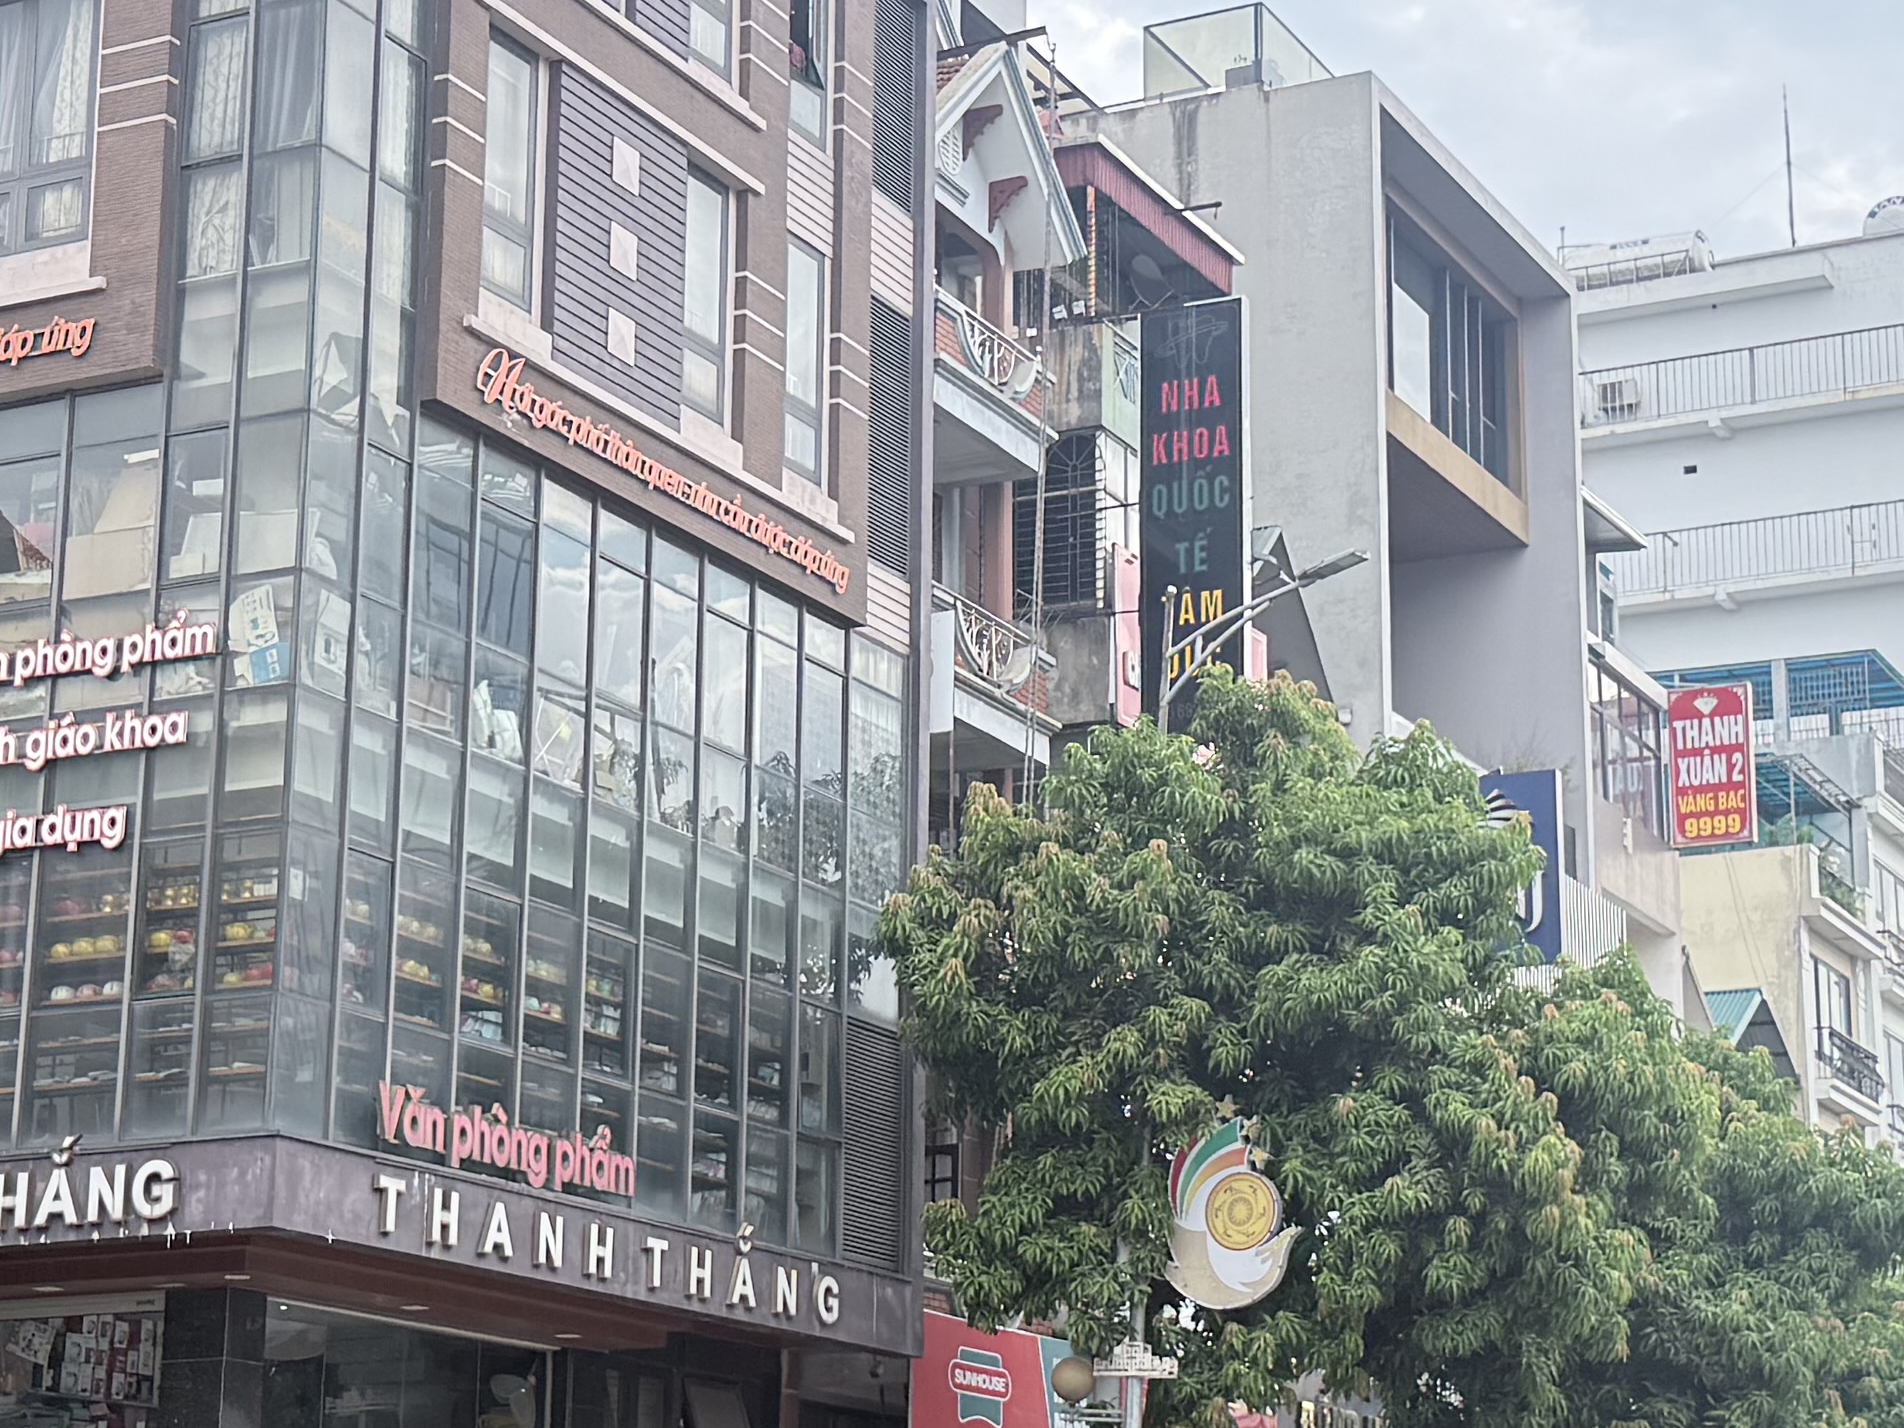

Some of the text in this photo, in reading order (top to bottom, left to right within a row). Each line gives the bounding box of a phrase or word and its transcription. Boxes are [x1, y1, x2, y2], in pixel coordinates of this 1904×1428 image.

[42, 316, 95, 357] ứng
[1161, 375, 1221, 413] NHA
[1153, 425, 1231, 465] KHOA
[1152, 466, 1230, 520] QUỐC
[1175, 527, 1214, 572] TẾ
[14, 629, 117, 687] phòng
[120, 608, 217, 673] phẩm
[24, 711, 97, 772] giáo
[103, 710, 189, 752] khoa
[1677, 749, 1727, 787] XUÂN
[1731, 752, 1744, 782] 2
[1678, 789, 1745, 814] VÀNG BẠC
[41, 803, 128, 853] dụng
[1684, 814, 1741, 839] 9999
[377, 1080, 635, 1197] Văn phòng phẩm
[373, 1174, 840, 1326] THANH THẮNG
[954, 1368, 1007, 1393] SUNHOUSE
